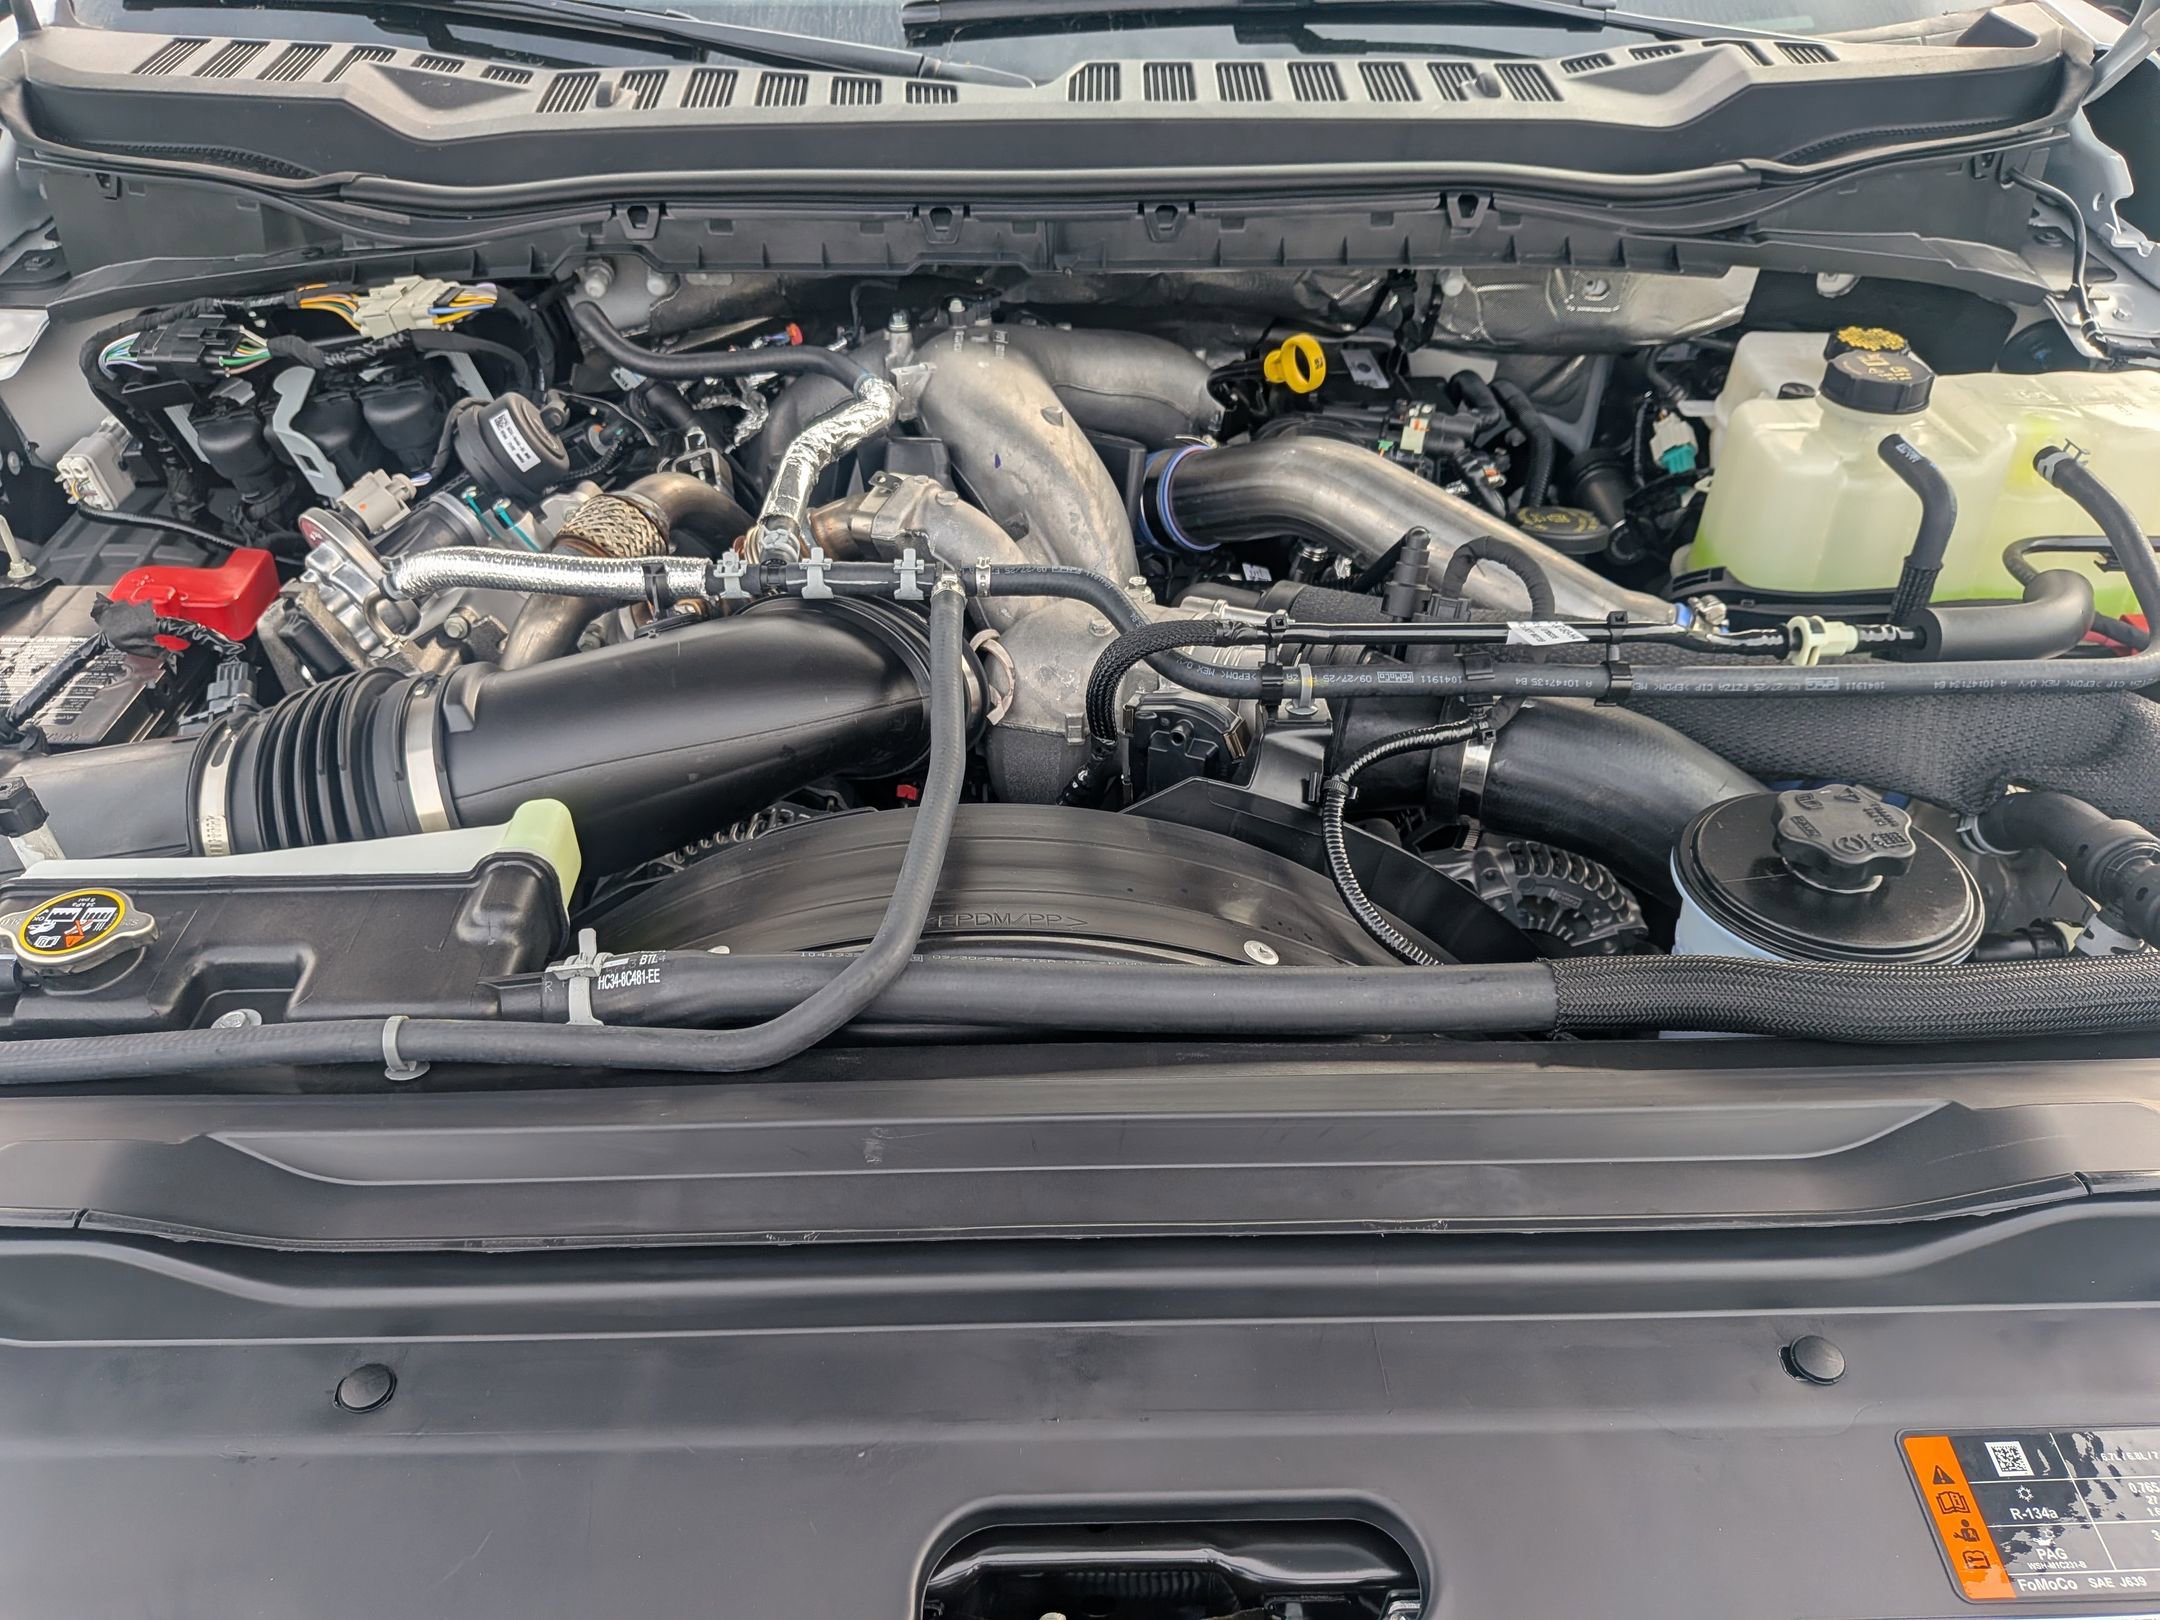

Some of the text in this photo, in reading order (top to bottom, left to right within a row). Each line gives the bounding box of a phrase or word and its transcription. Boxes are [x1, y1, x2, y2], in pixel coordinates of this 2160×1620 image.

[1196, 664, 1216, 677] MEX
[1377, 671, 1414, 683] FoMoCo
[1322, 674, 1373, 683] 09/27/25
[1420, 675, 1463, 684] 1041911
[1531, 679, 1580, 687] 10:47:35
[597, 968, 661, 990] HC34-8C481-EE
[2009, 1507, 2059, 1520] R-134a
[2035, 1547, 2068, 1561] PAG
[2017, 1576, 2148, 1592] FoMoCo SAE J639
